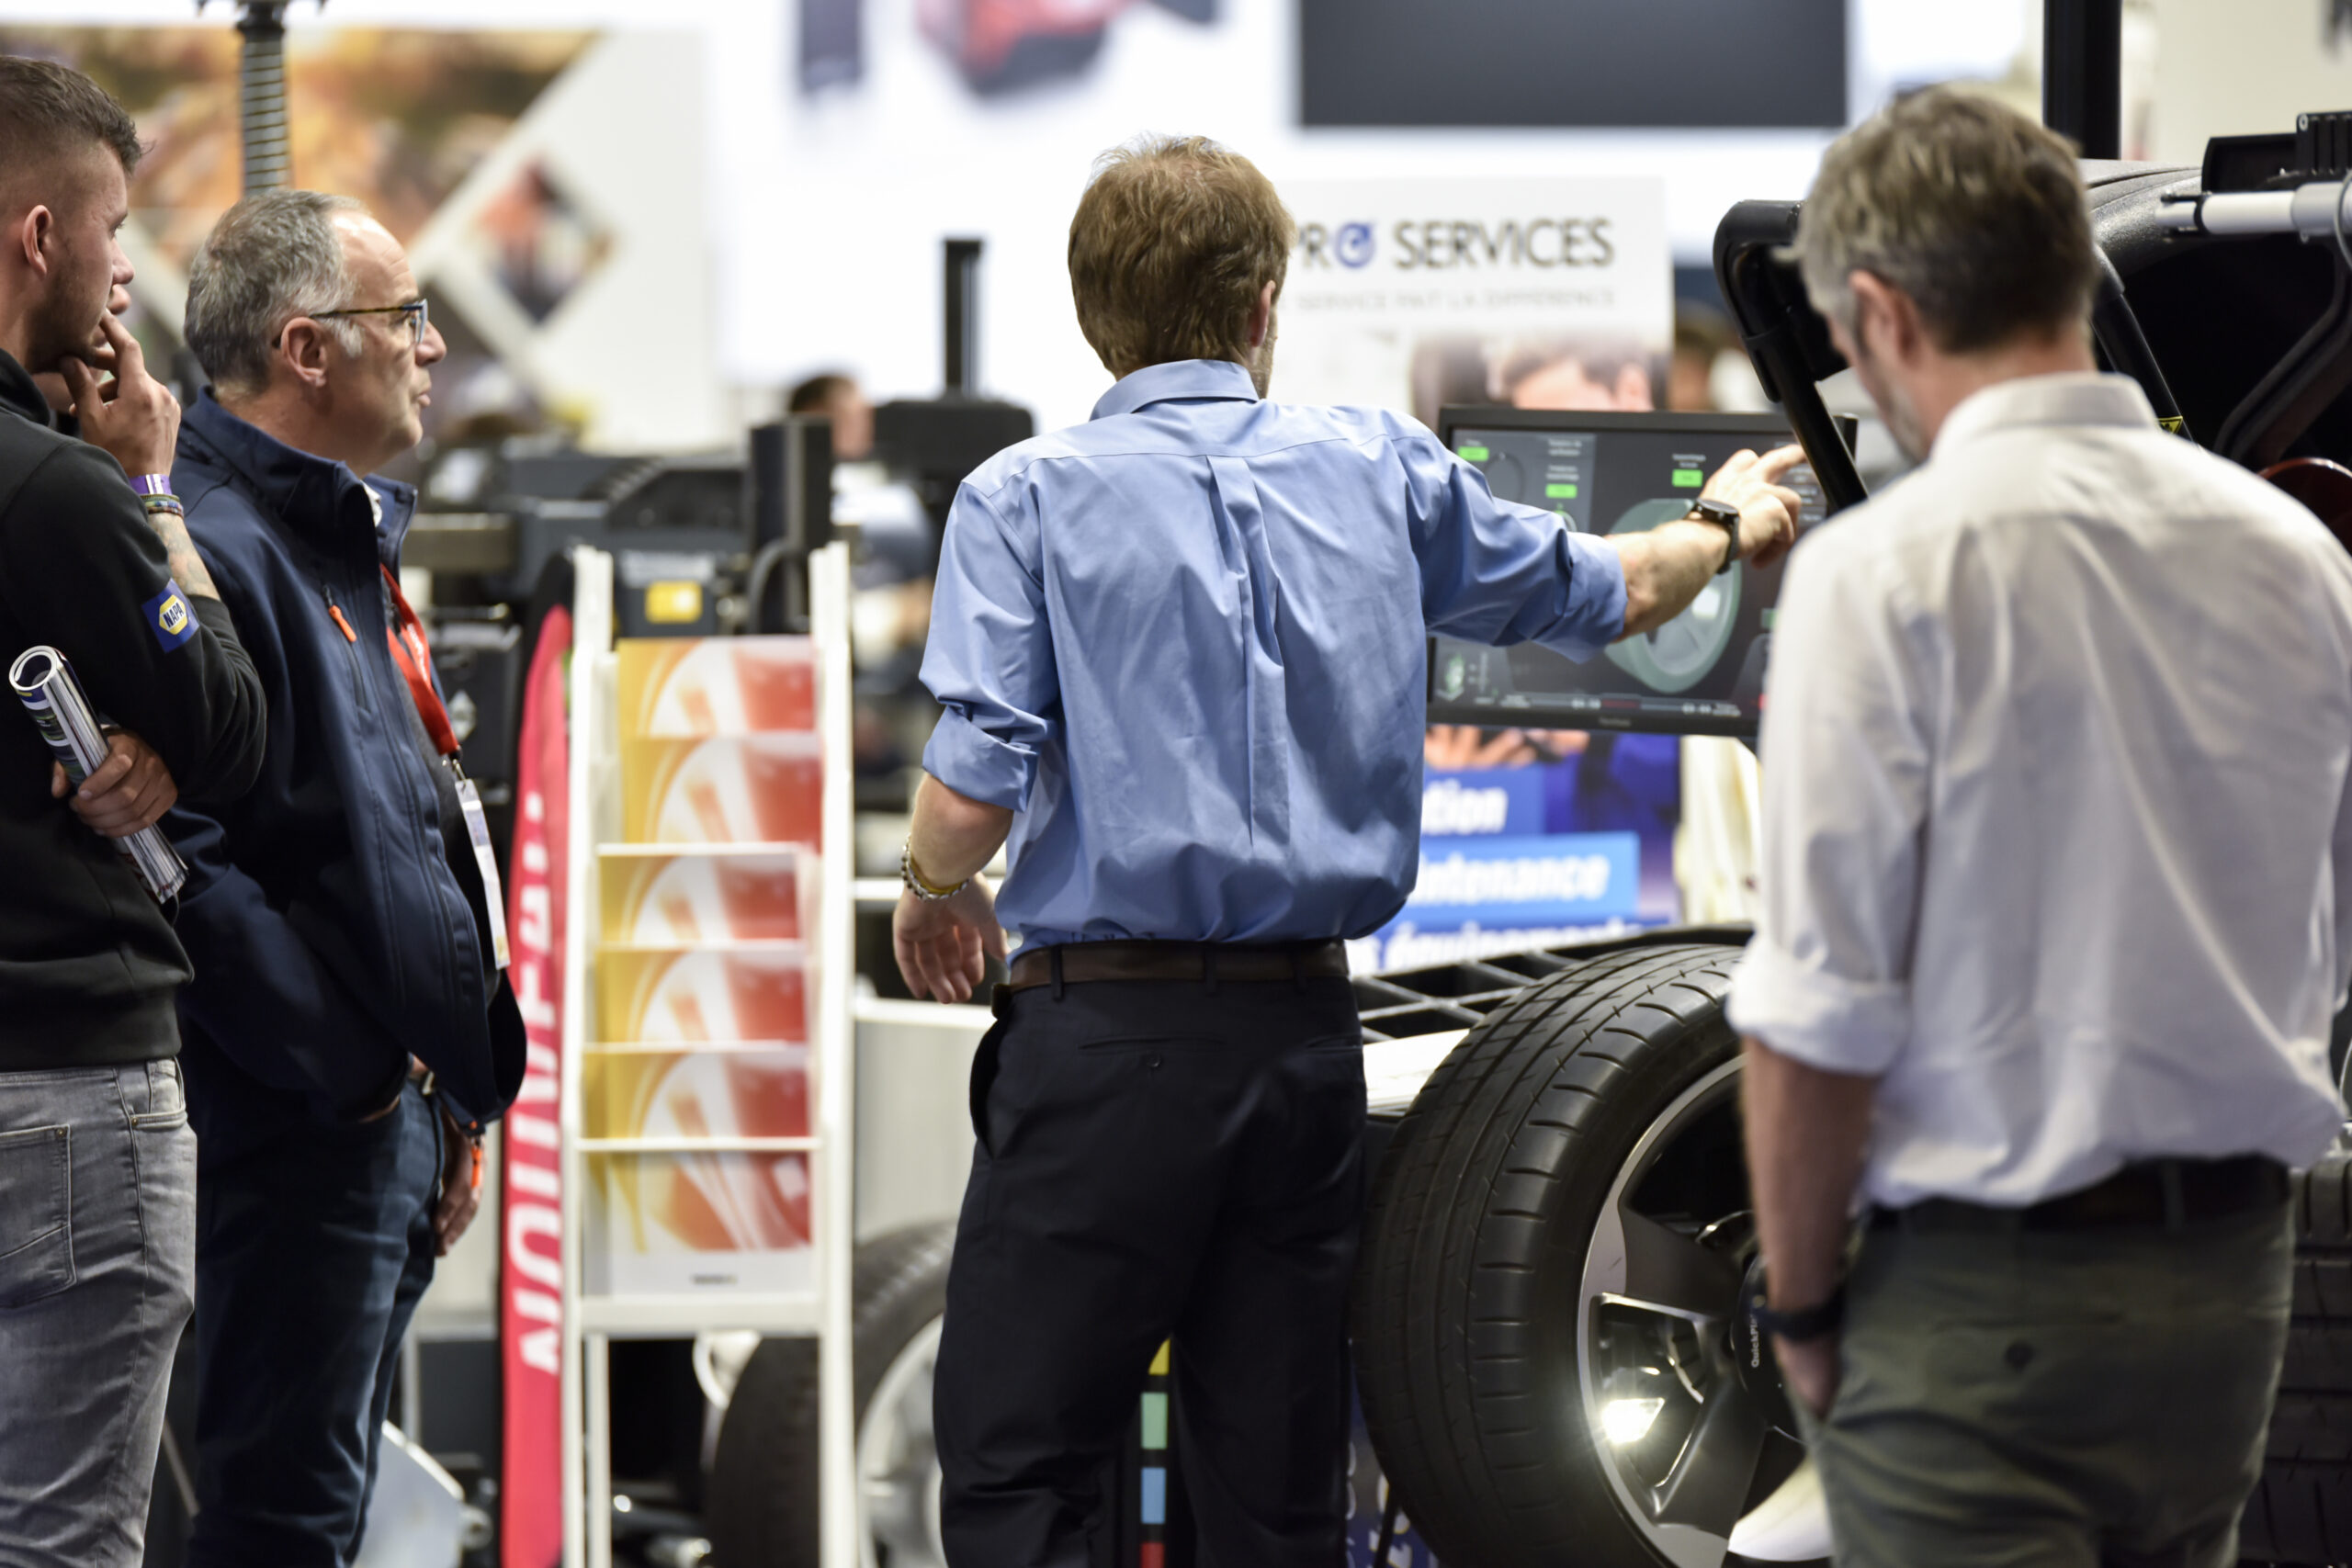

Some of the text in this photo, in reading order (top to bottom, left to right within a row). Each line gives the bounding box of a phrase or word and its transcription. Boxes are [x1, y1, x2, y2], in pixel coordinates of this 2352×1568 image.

[1392, 218, 1616, 271] SERVICES
[164, 602, 184, 628] NAPA
[1421, 780, 1506, 833] tion
[1409, 852, 1611, 904] intenance
